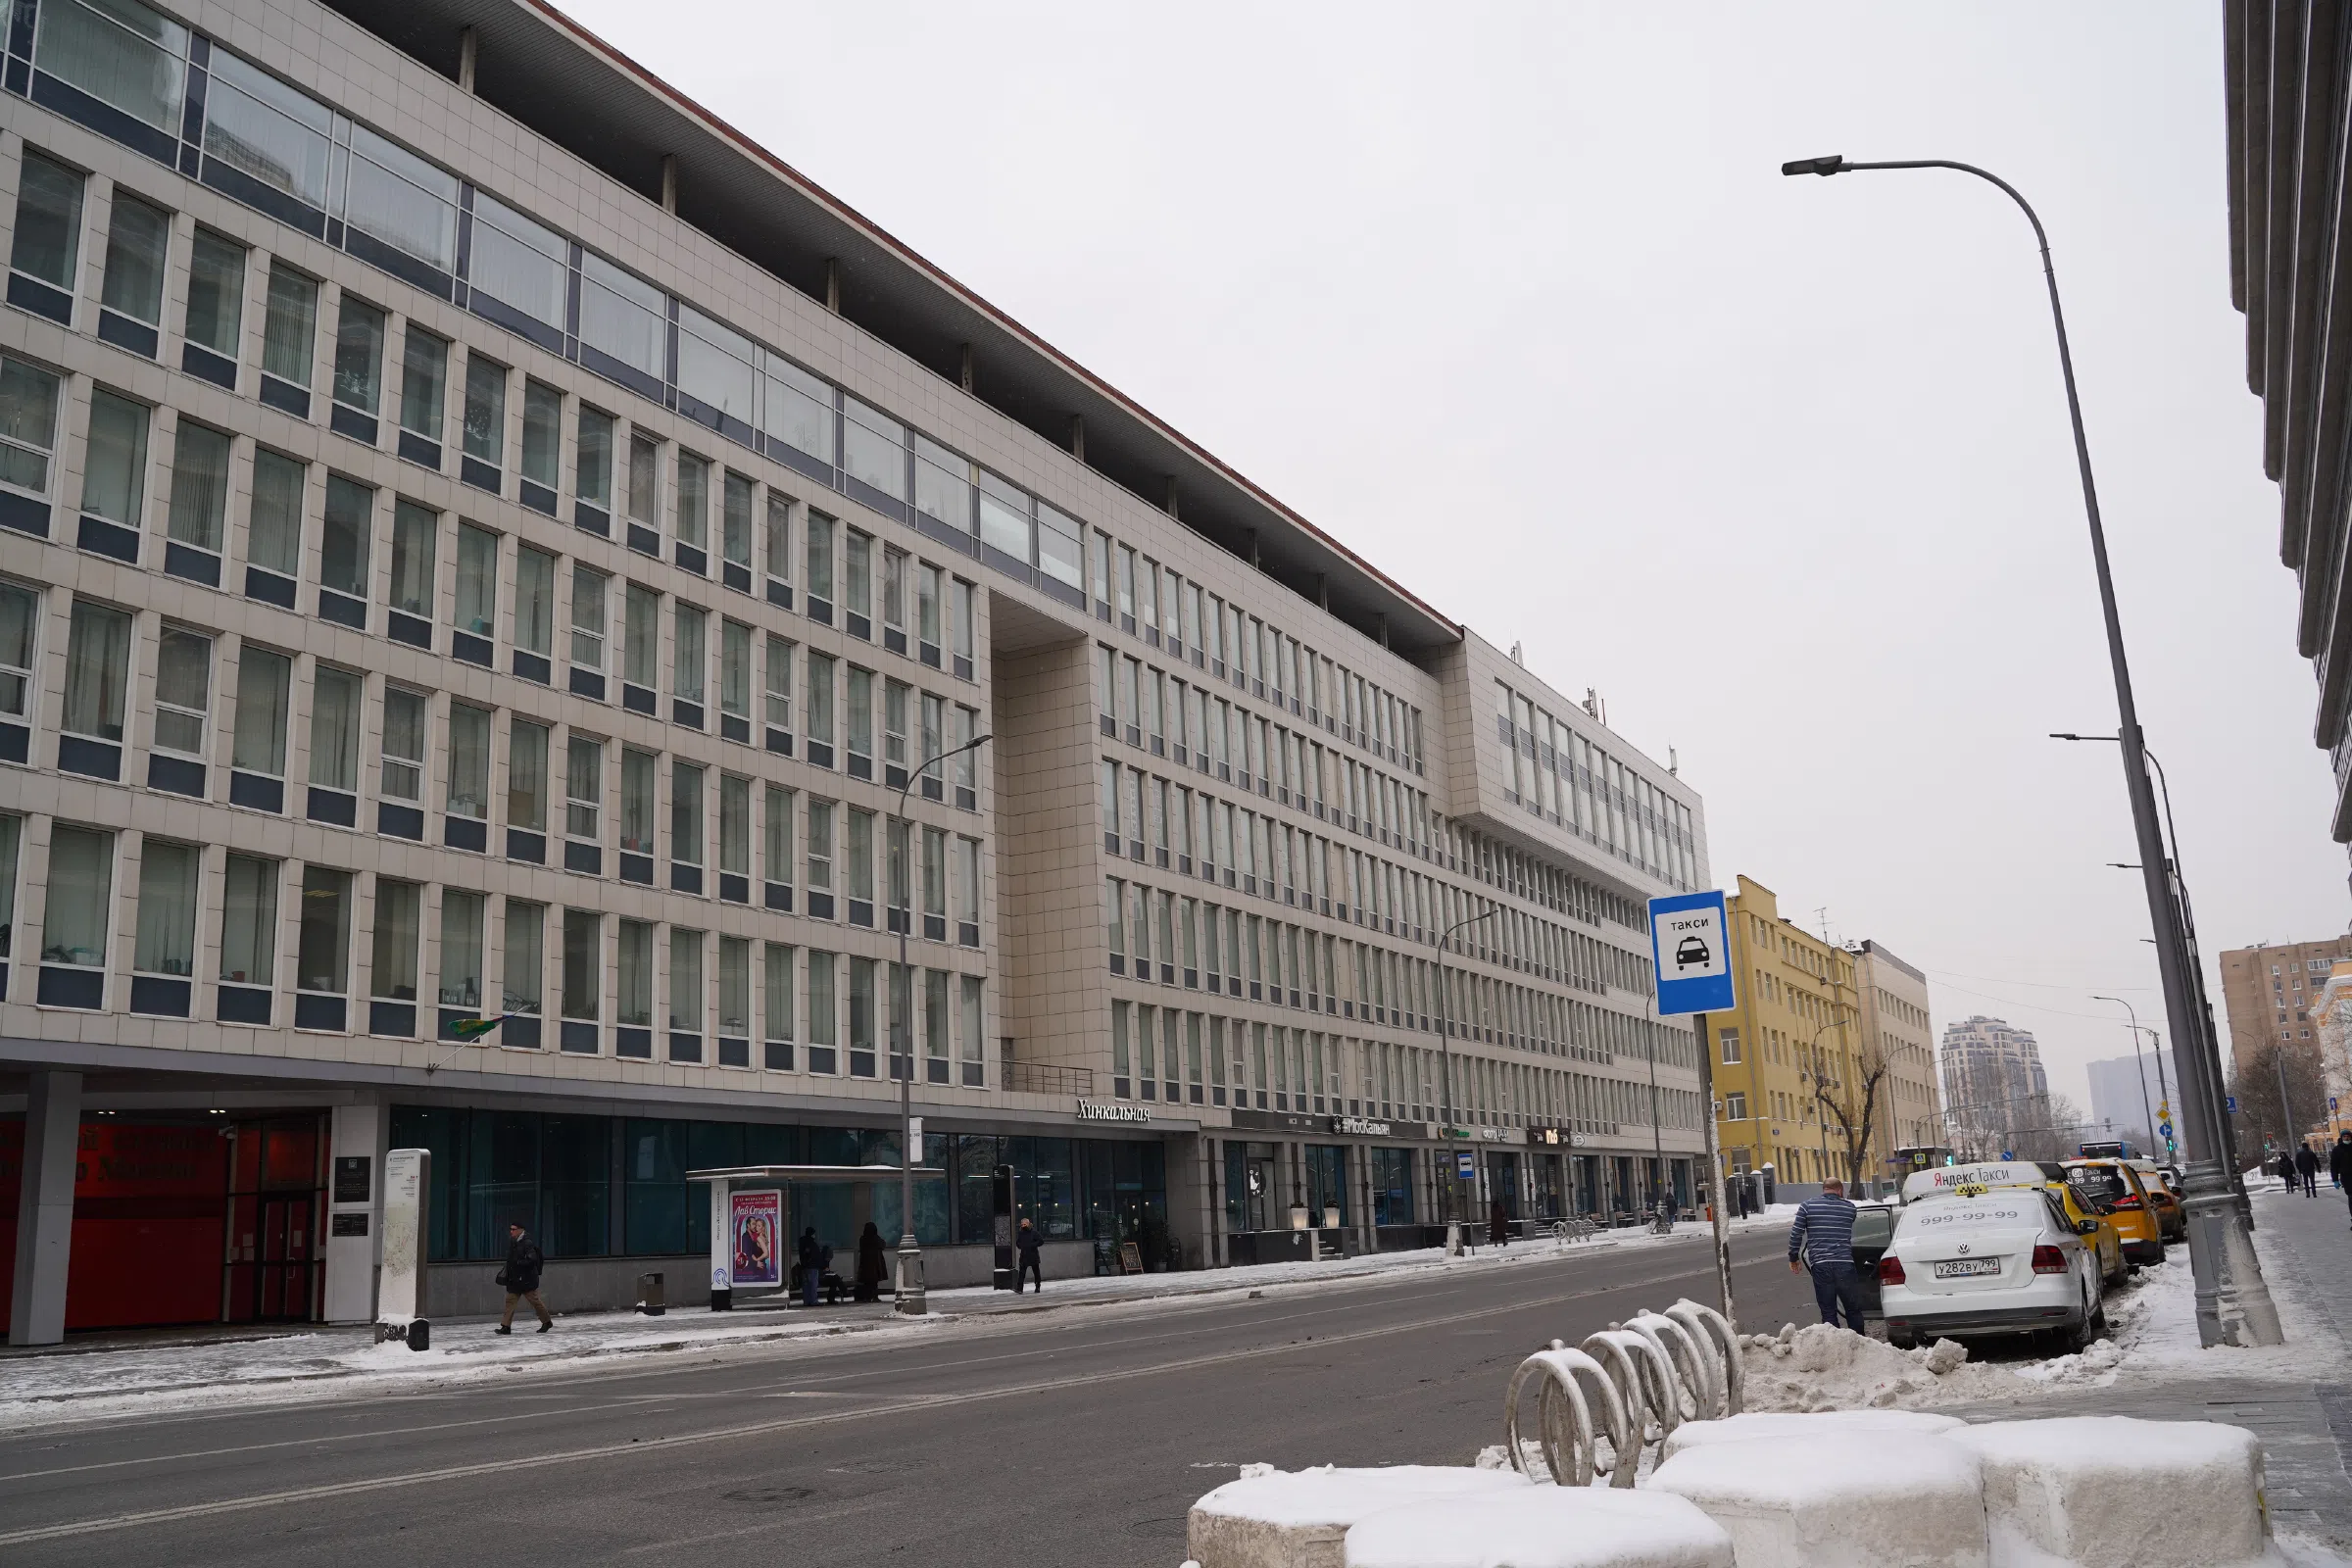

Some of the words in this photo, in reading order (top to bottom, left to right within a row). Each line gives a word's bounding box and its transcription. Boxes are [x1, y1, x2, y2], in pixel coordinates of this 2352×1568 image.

[1671, 918, 1709, 931] такси
[1077, 1099, 1151, 1122] Хинкальная
[1342, 1117, 1391, 1136] #МосКальян
[1934, 1172, 1975, 1187] Яндекс
[1976, 1167, 2010, 1182] Такси
[735, 1205, 749, 1216] Лав
[749, 1204, 776, 1217] Сторис
[1921, 1211, 2018, 1226] 999-99-99
[1980, 1259, 1996, 1268] 799
